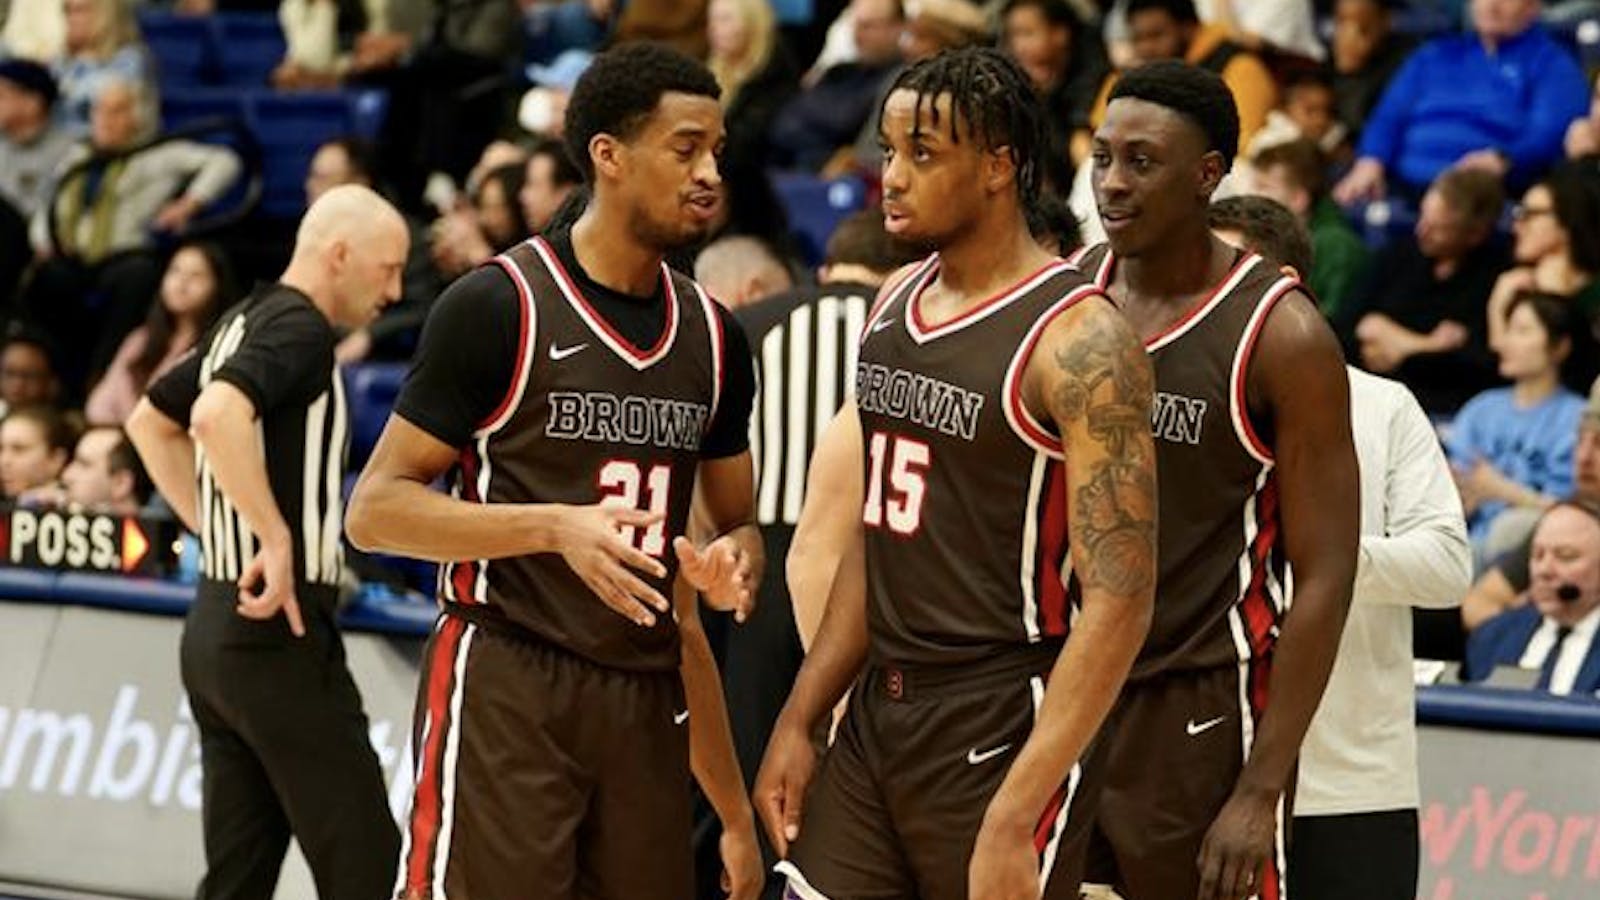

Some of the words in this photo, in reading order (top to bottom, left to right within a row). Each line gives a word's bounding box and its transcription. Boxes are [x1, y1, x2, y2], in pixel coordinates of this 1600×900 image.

[545, 391, 708, 451] BROWN
[597, 458, 672, 558] 21
[862, 431, 931, 536] 15
[10, 509, 121, 570] POSS.
[0, 684, 202, 809] mbi
